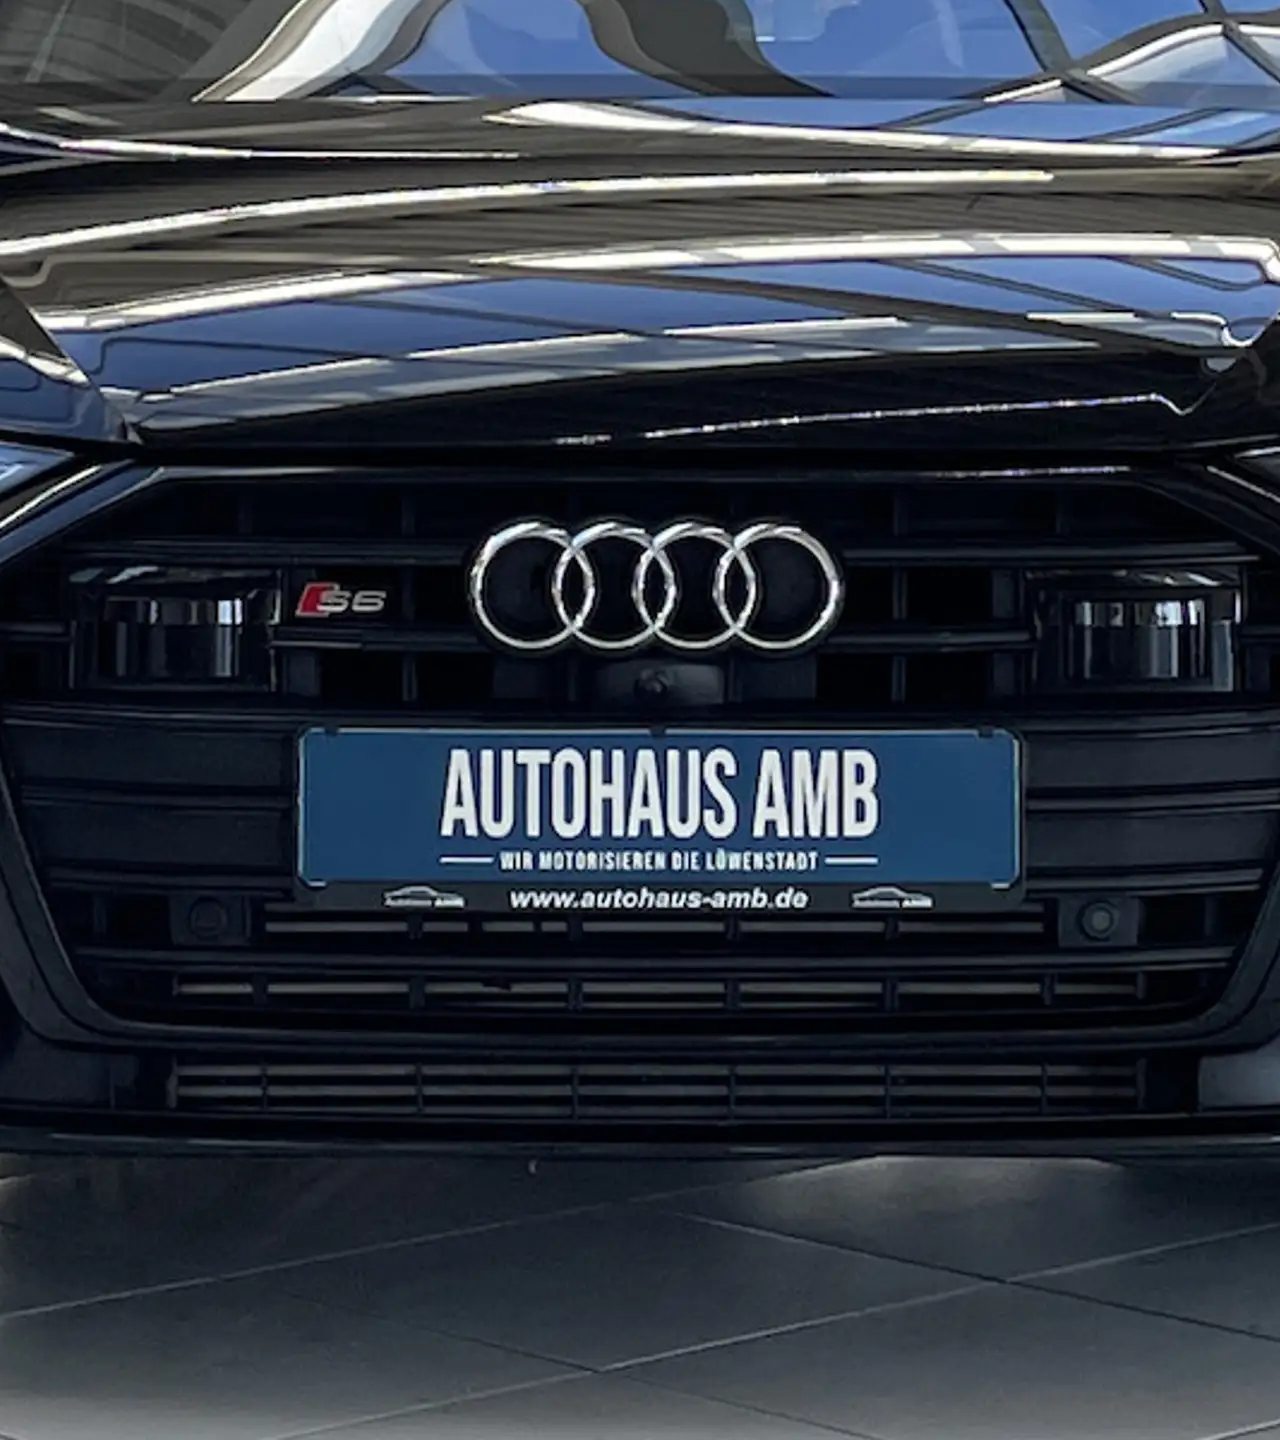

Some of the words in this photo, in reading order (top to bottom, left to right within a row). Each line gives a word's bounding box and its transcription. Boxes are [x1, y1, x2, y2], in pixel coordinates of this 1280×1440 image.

[440, 748, 739, 839] AUTOHAUS
[752, 749, 880, 838] AMB
[500, 850, 534, 871] WIR
[538, 851, 667, 871] MOTORISIEREN
[671, 851, 701, 872] DIE
[706, 848, 819, 872] LÖWENSTADT
[510, 886, 809, 910] www.autohaus-amb.de
